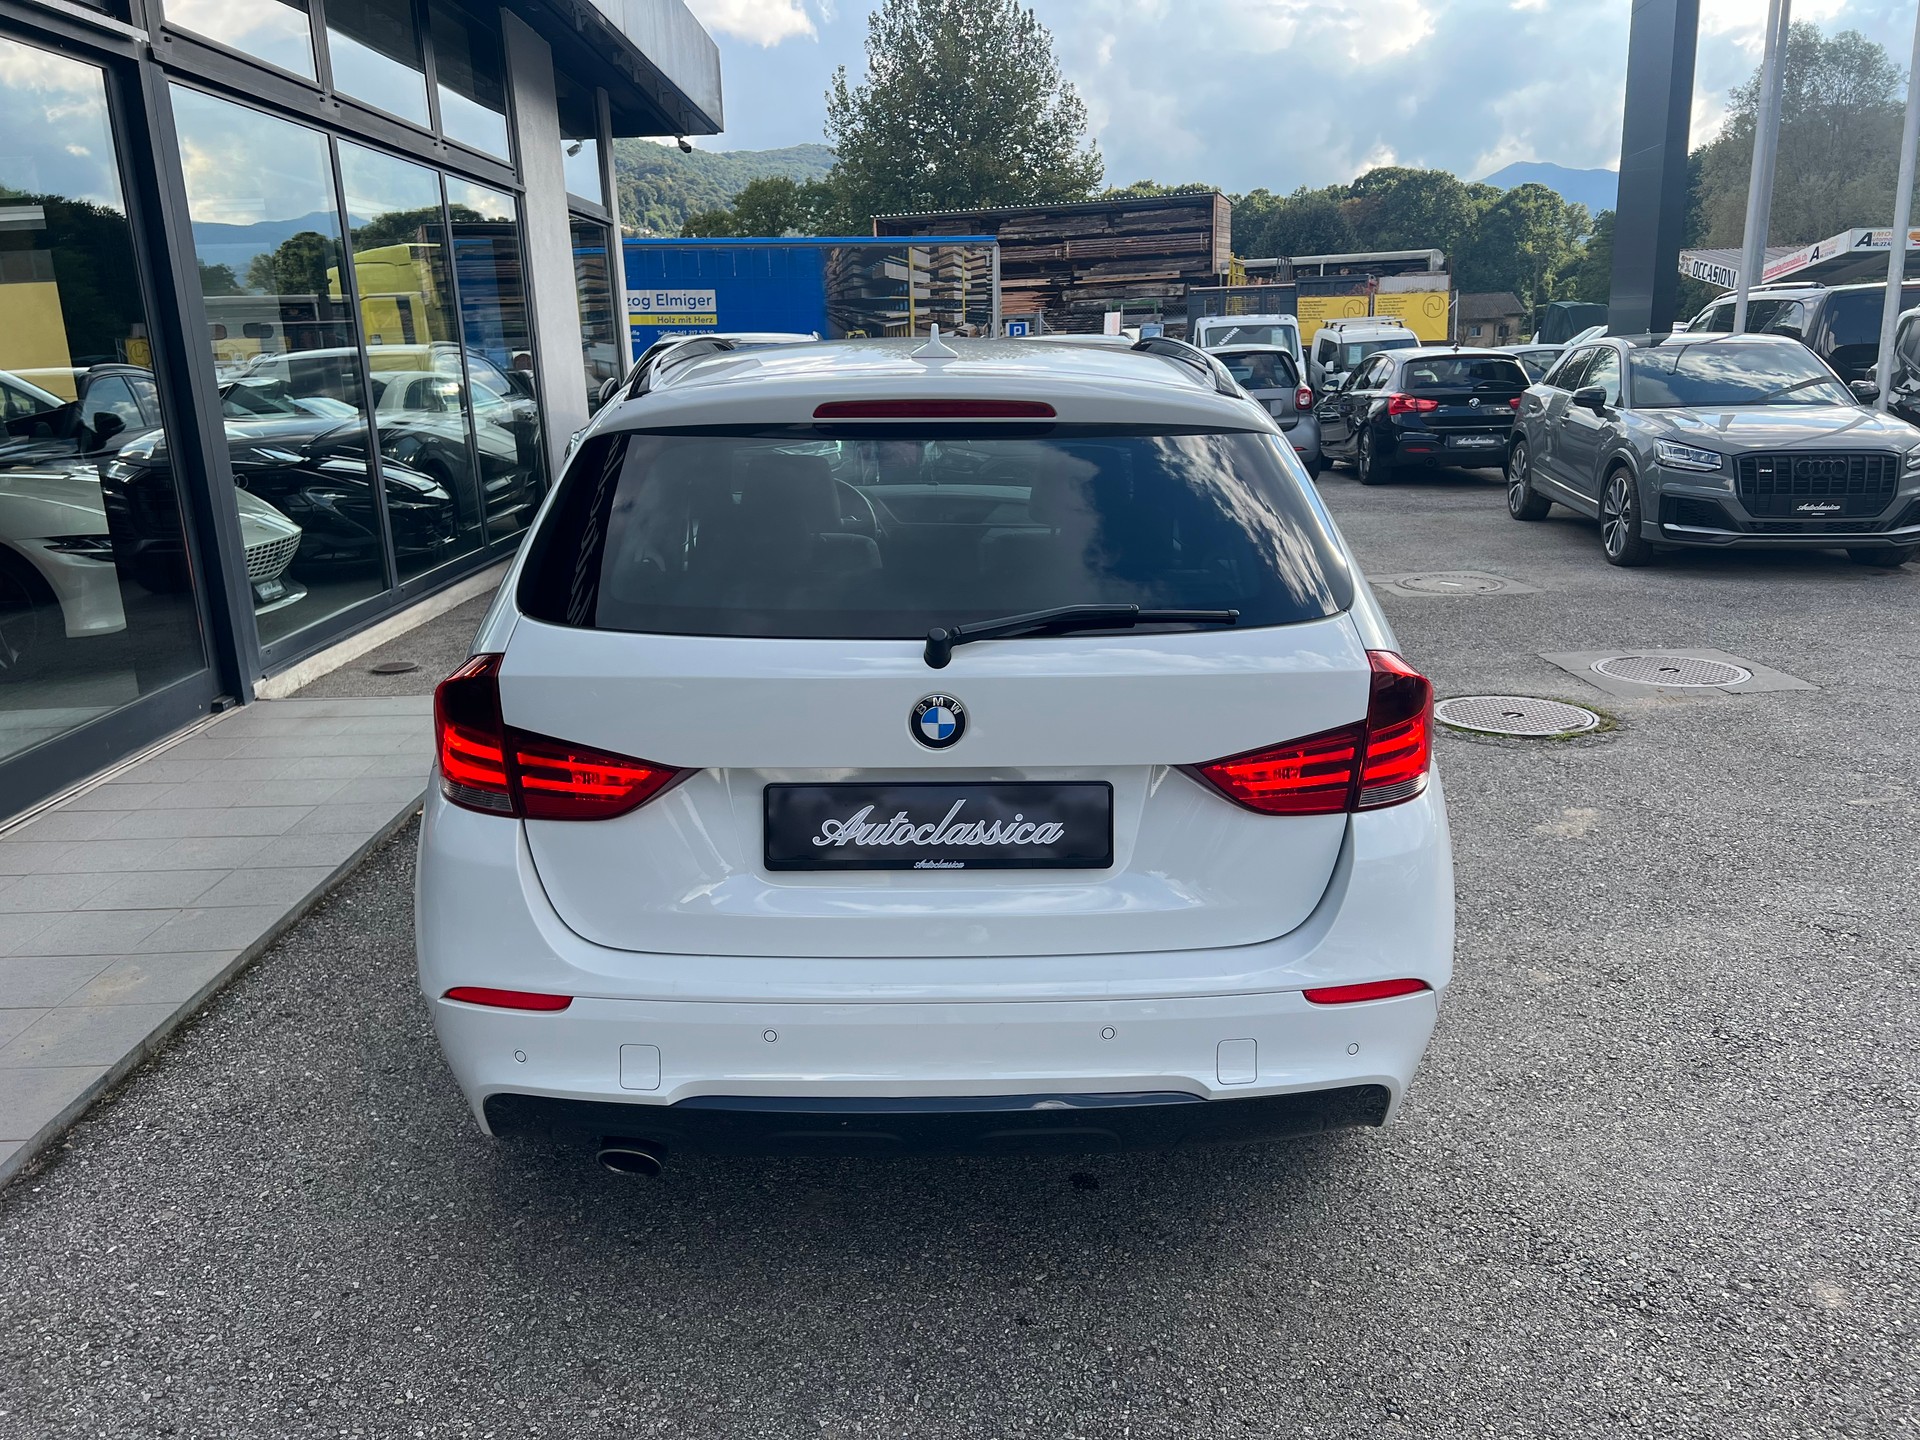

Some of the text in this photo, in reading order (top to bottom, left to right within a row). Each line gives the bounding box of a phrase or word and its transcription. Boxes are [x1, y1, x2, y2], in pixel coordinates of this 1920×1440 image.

[656, 293, 712, 310] Elmiger
[657, 316, 714, 324] Holz mit Herz
[1014, 326, 1022, 337] P
[1217, 326, 1241, 347] ASIONE
[915, 696, 962, 716] BMW
[812, 799, 1064, 847] Autoclassica
